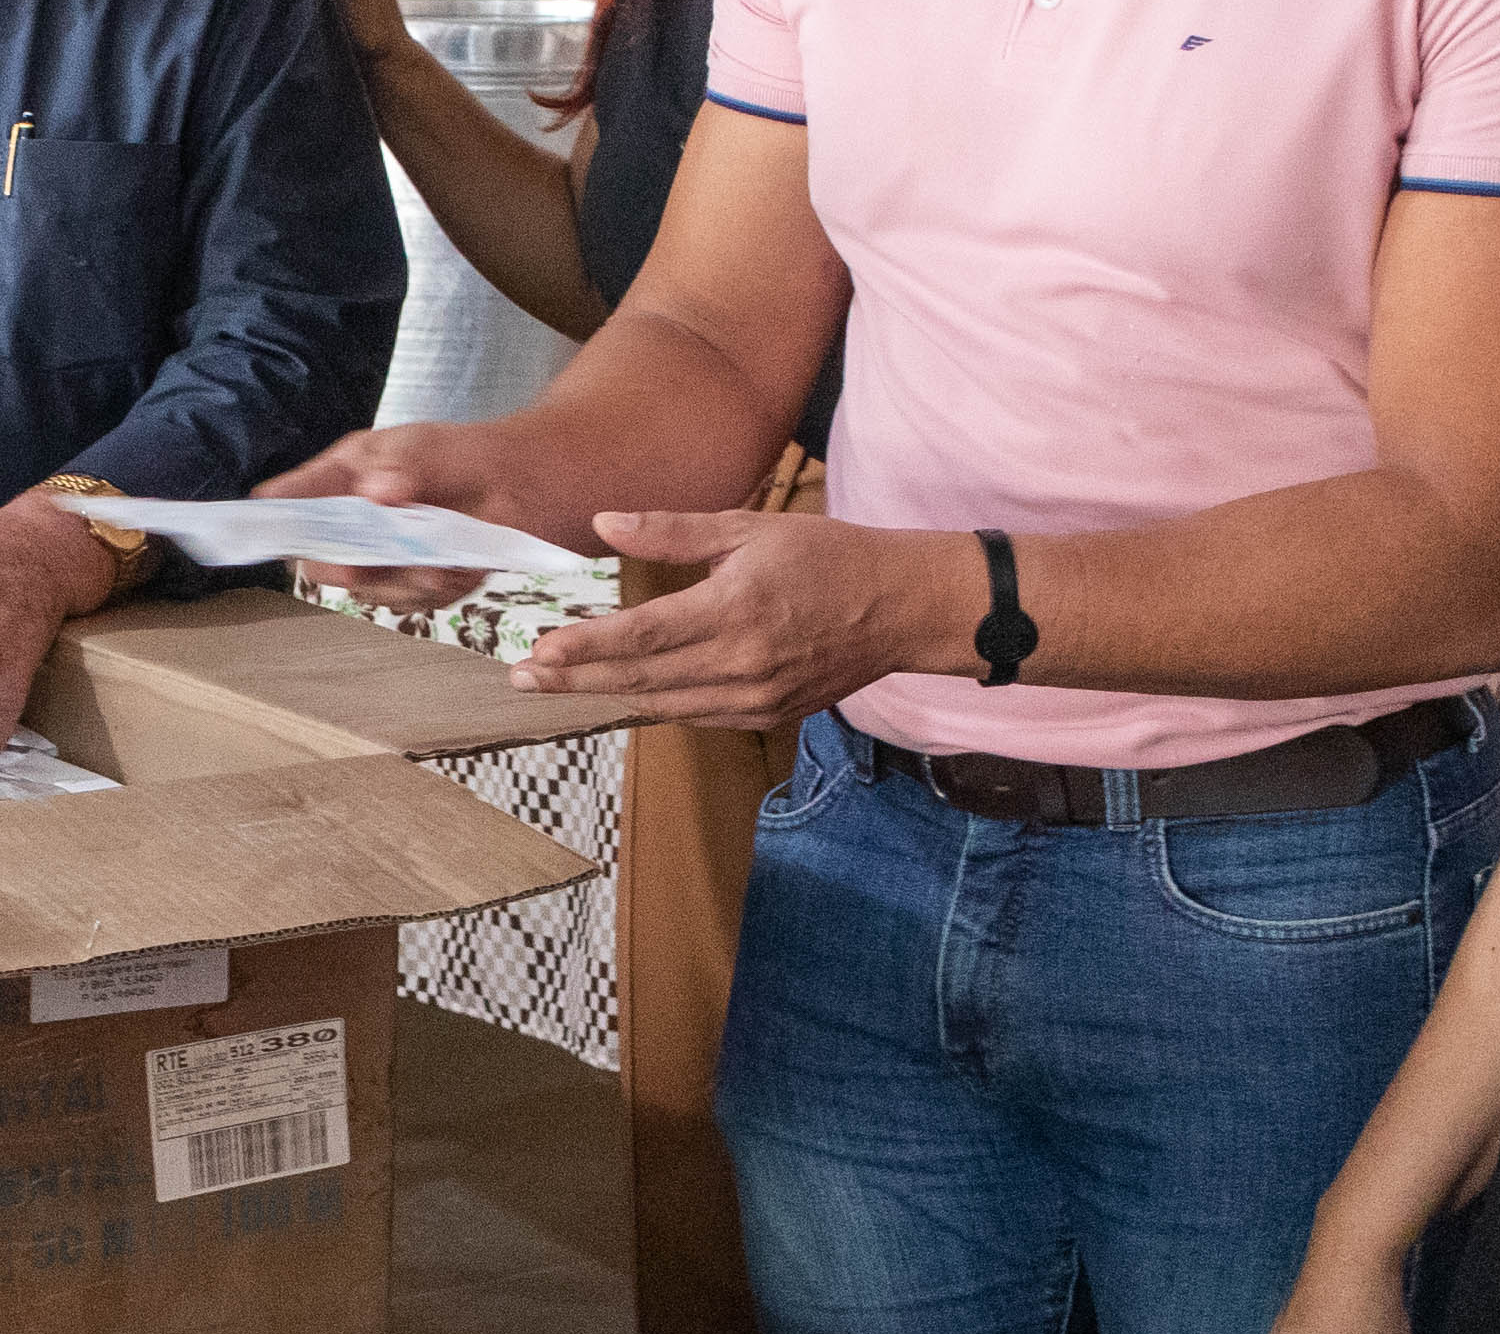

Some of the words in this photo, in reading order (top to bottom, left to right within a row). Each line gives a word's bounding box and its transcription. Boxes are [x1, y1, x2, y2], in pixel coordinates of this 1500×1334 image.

[155, 1050, 189, 1073] RTE
[229, 1043, 254, 1059] 512
[261, 1027, 338, 1054] 380
